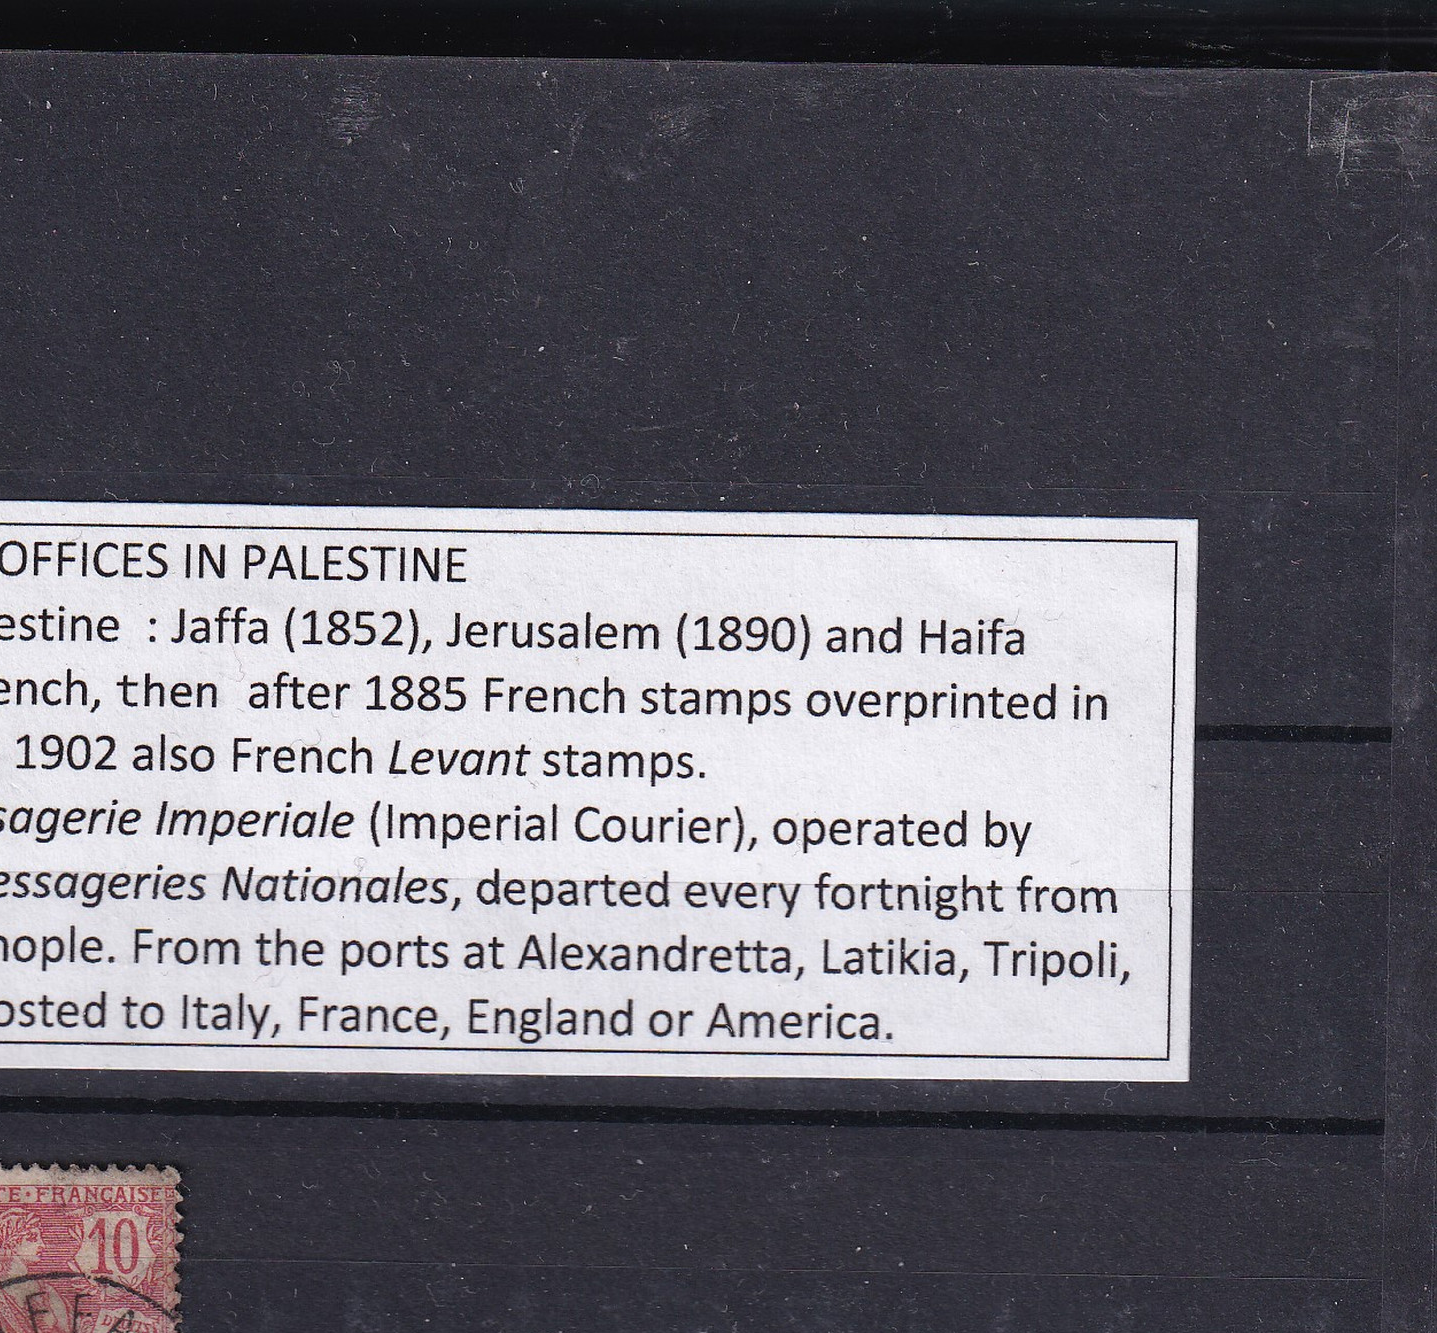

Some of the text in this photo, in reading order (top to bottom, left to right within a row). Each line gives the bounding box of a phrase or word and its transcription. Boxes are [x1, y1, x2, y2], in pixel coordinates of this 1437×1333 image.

[185, 543, 226, 579] IN
[244, 544, 468, 583] PALESTINE
[170, 606, 268, 645] Jaffa
[284, 606, 432, 655] (1852),
[446, 611, 660, 650] Jerusalem
[676, 612, 811, 661] (1890)
[826, 616, 903, 654] and
[920, 617, 1025, 656] Haifa
[116, 672, 218, 708] then
[248, 671, 351, 711] after
[366, 675, 467, 712] 1885
[484, 676, 625, 714] French
[640, 682, 792, 725] stamps
[806, 682, 1057, 727] overprinted
[1073, 684, 1108, 721] in
[16, 734, 117, 771] 1902
[132, 733, 215, 773] also
[232, 736, 373, 775] French
[388, 739, 532, 777] Levant
[542, 744, 706, 787] stamps.
[155, 800, 355, 846] Imperiale
[370, 800, 558, 849] (Imperial
[574, 805, 757, 853] Courier),
[773, 809, 967, 854] operated
[985, 809, 1033, 858] by
[222, 866, 461, 912] Nationales,
[476, 868, 670, 915] departed
[684, 881, 802, 918] every
[814, 871, 1004, 921] fortnight
[1016, 874, 1118, 914] from
[133, 928, 240, 965] From
[255, 928, 324, 967] the
[341, 935, 449, 976] ports
[463, 936, 505, 970] at
[517, 932, 804, 981] Alexandretta,
[823, 937, 969, 984] Latikia,
[983, 939, 1130, 986] Tripoli,
[121, 996, 164, 1030] to
[182, 992, 280, 1038] Italy,
[299, 996, 450, 1040] France,
[468, 997, 634, 1041] England
[648, 1009, 694, 1038] or
[706, 1002, 893, 1041] America.
[35, 1186, 162, 1206] FRANÇAISE
[87, 1217, 140, 1275] 10
